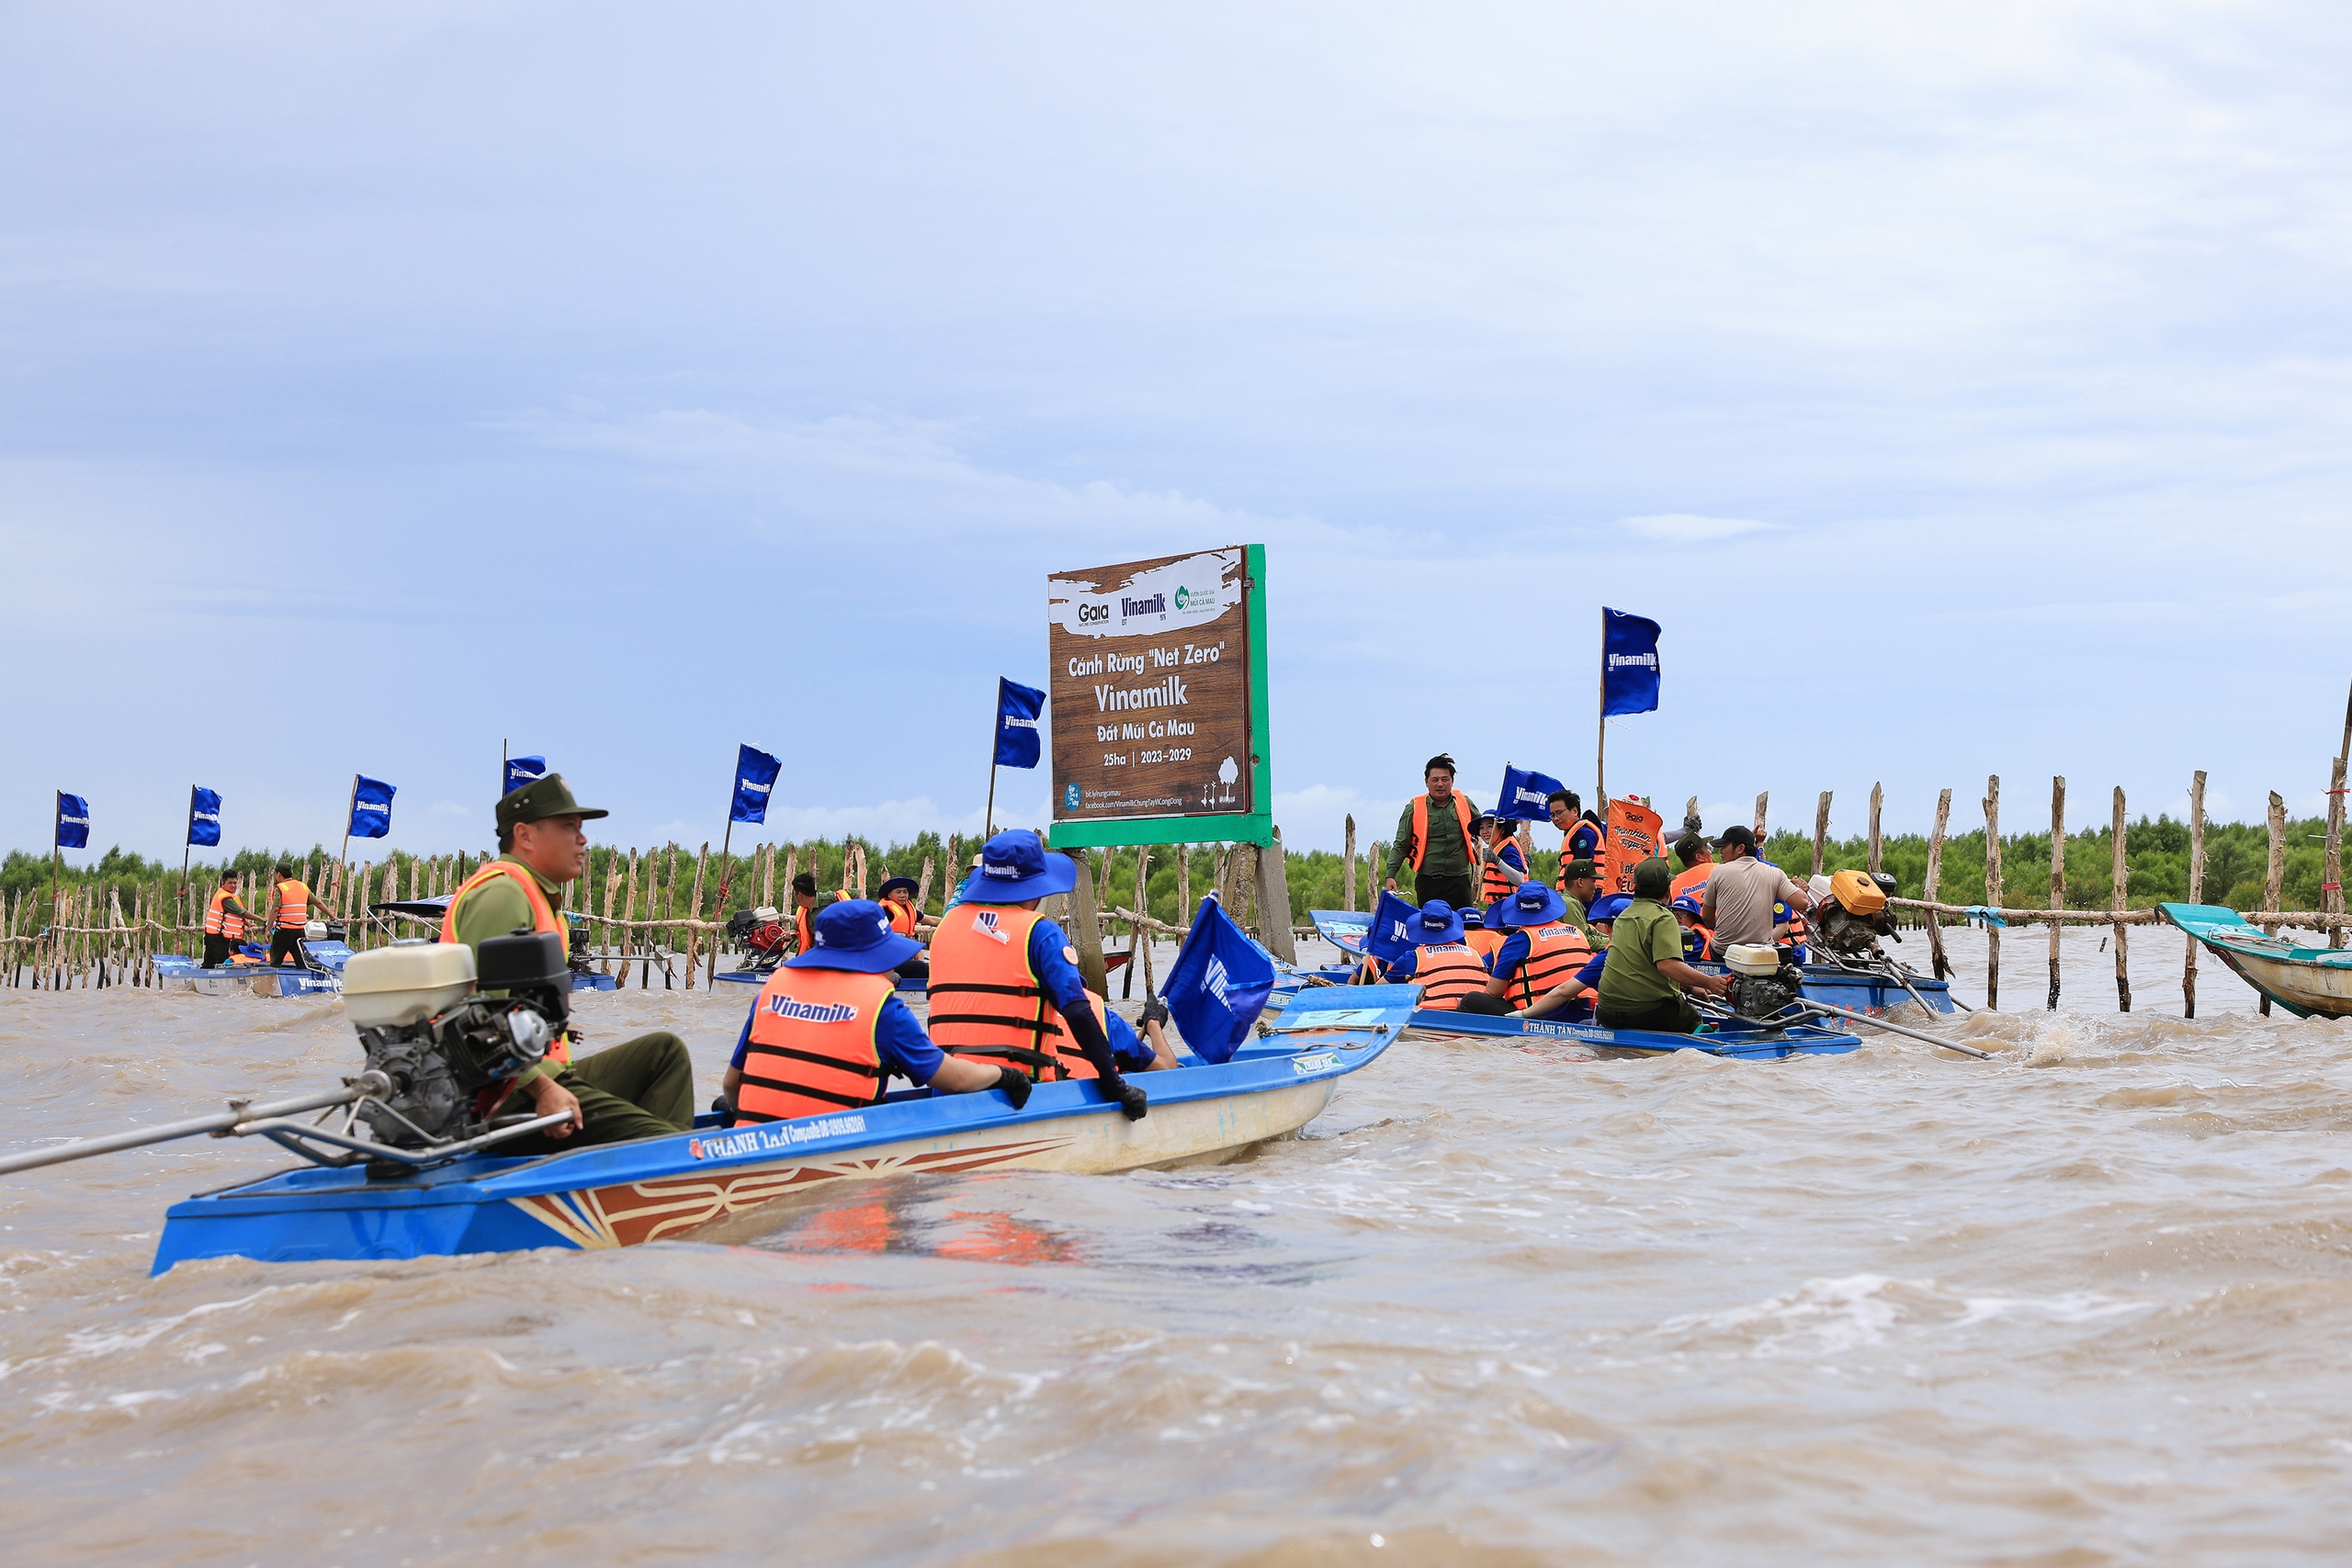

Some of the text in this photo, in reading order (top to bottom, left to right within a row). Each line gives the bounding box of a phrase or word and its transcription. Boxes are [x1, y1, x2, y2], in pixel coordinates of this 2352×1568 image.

[1121, 593, 1166, 617] Vinamilk
[1079, 602, 1109, 622] Gaia
[1069, 653, 1102, 677] Cánh
[1148, 649, 1180, 669] "Net
[1184, 641, 1226, 665] Zero"
[1608, 653, 1657, 666] Vinamilk
[1095, 676, 1189, 712] Vinamilk
[1097, 724, 1119, 742] Đất
[1148, 720, 1164, 739] Cà
[1167, 718, 1194, 737] Mau
[1103, 752, 1126, 766] 25ha
[1516, 785, 1549, 806] Vinamilk
[356, 800, 390, 812] Vinamilk
[1625, 812, 1644, 822] Gaia
[1539, 926, 1577, 937] Vinamilk
[1426, 944, 1470, 953] Vinamilk
[298, 977, 344, 987] Vinamlk
[1530, 1021, 1555, 1034] THÀNH
